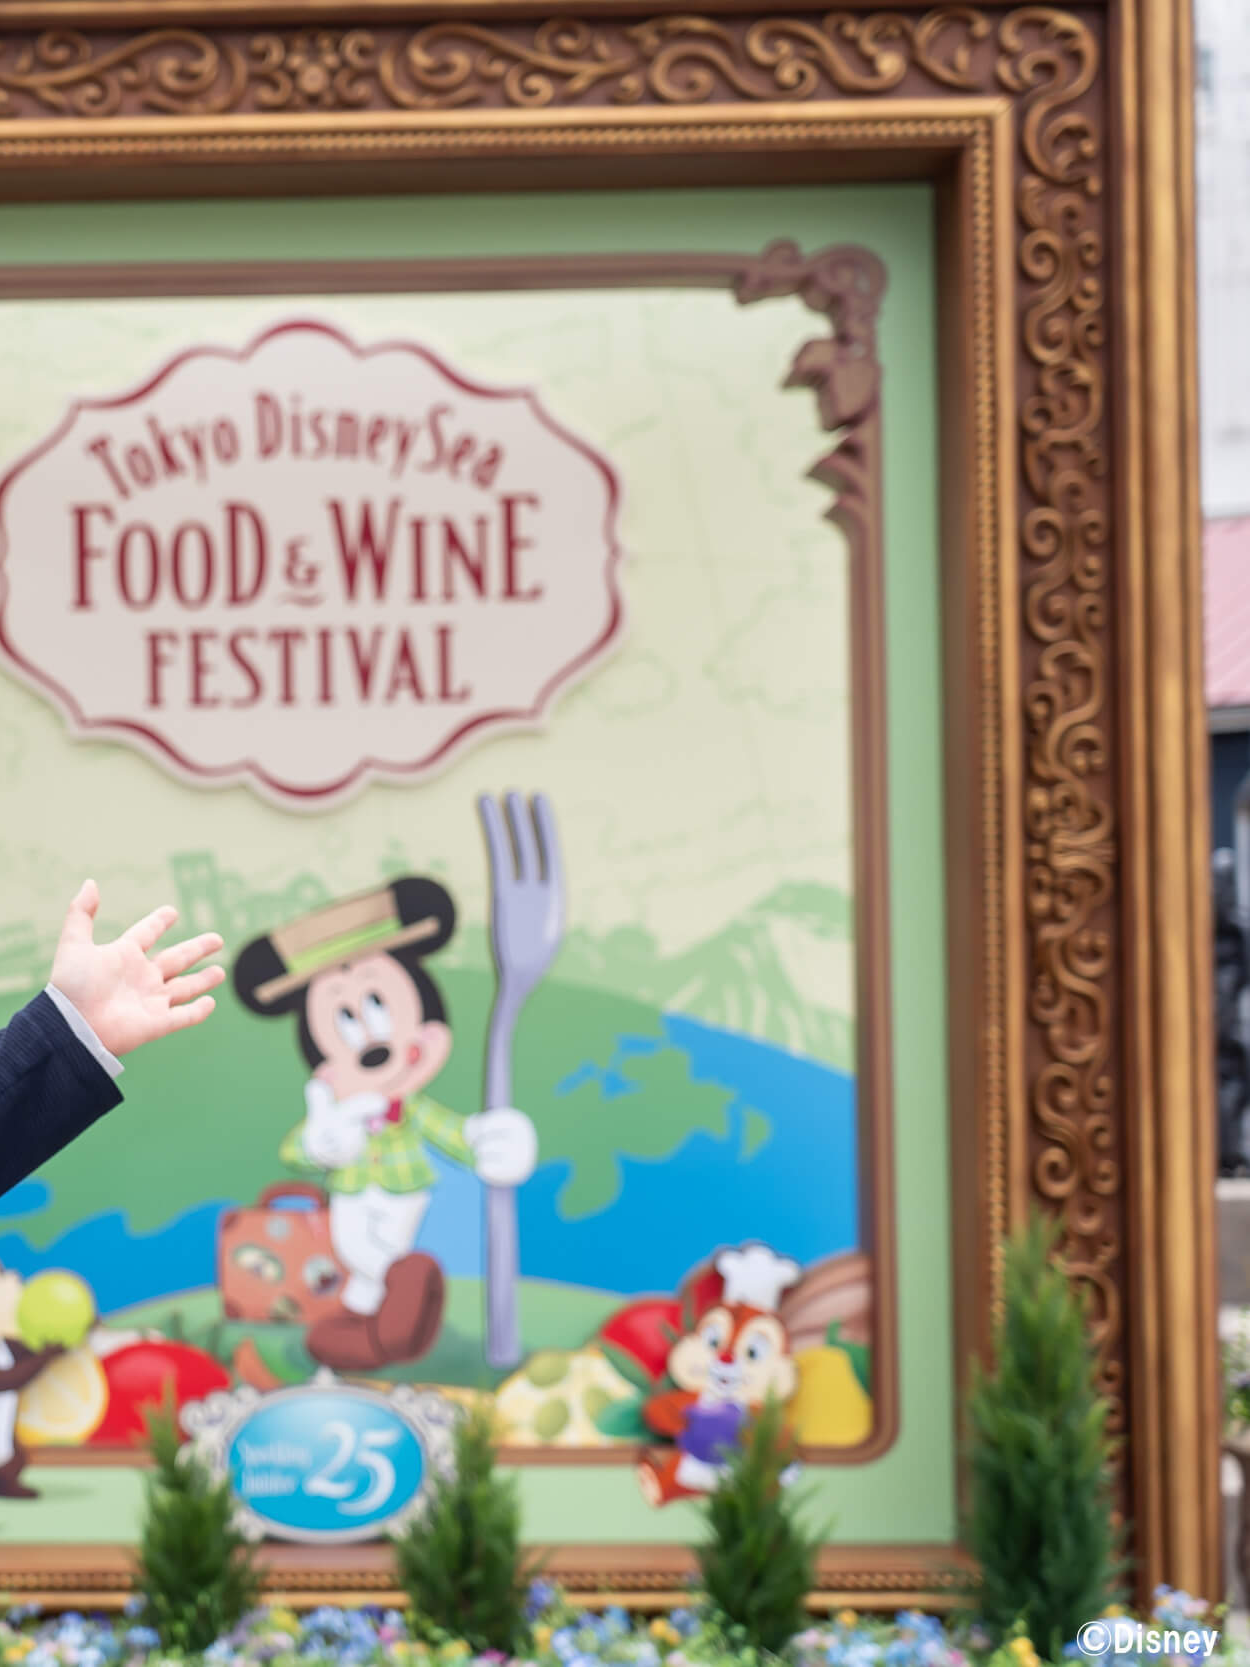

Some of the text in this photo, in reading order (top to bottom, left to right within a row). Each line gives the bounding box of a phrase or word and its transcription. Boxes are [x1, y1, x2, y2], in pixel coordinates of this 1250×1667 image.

[86, 391, 505, 499] Tokyo DisneySea
[70, 493, 544, 611] FOOD & WINE
[145, 622, 472, 709] FESTIVAL
[302, 1420, 400, 1516] 25
